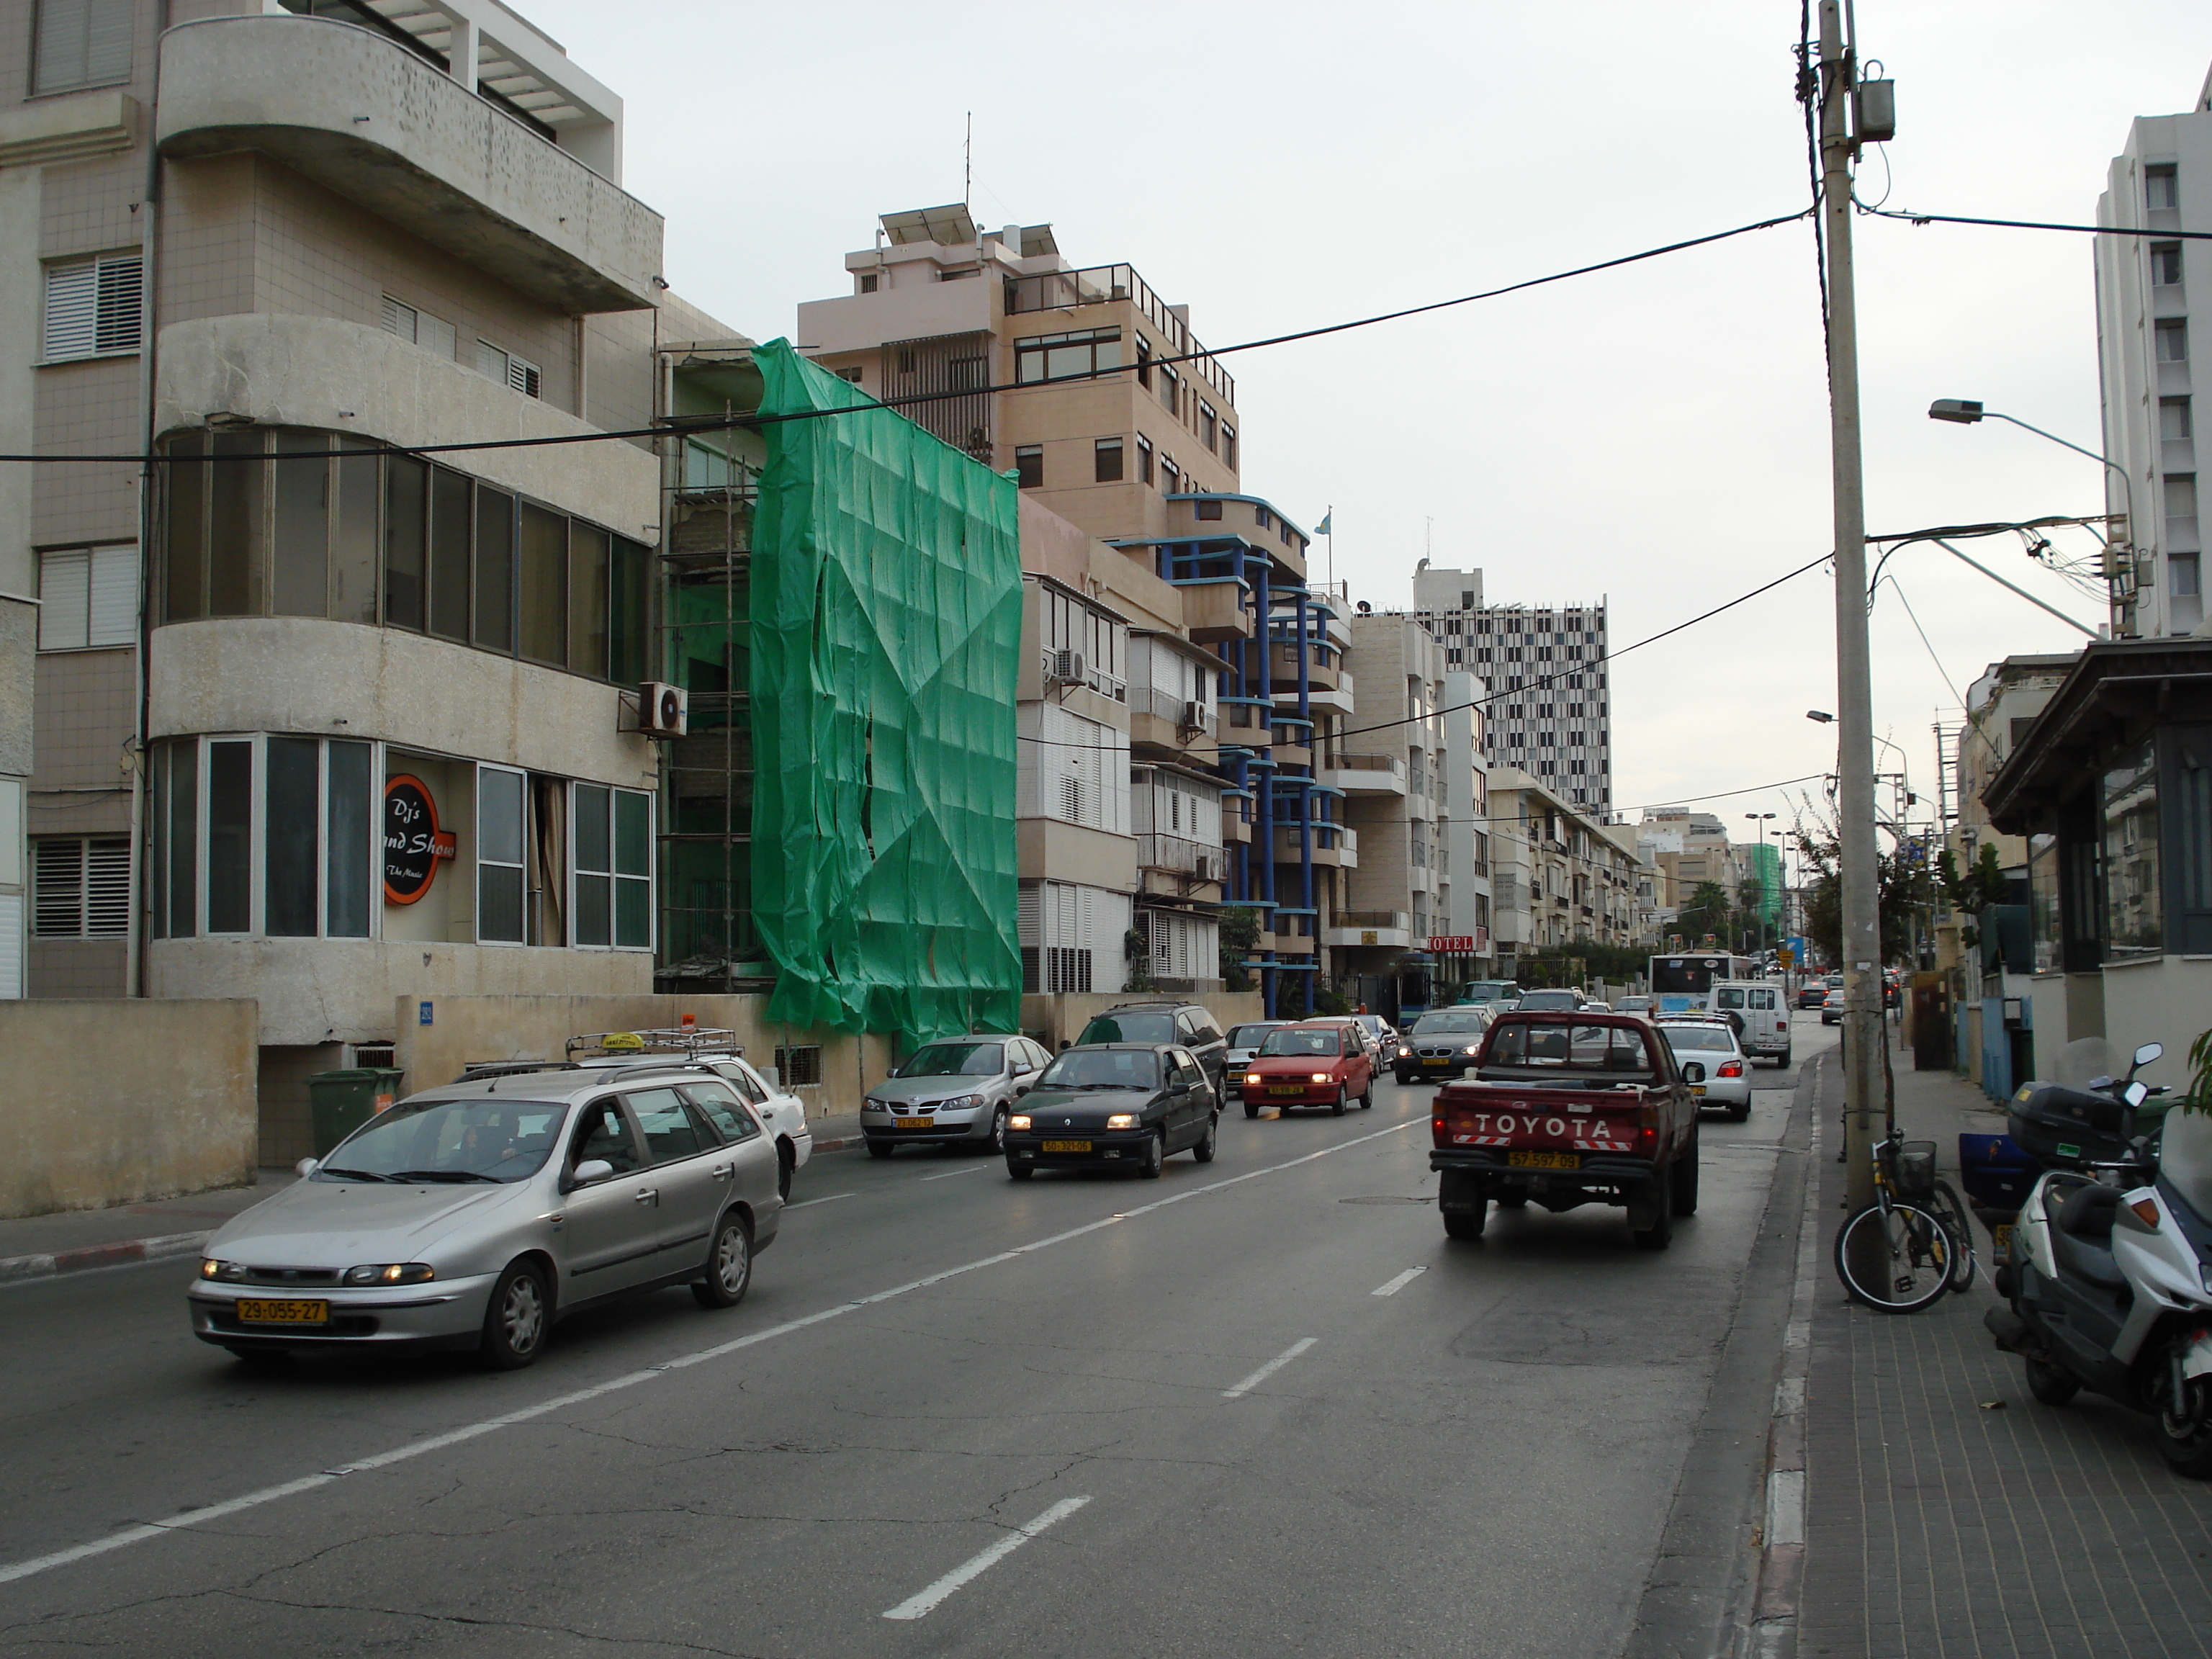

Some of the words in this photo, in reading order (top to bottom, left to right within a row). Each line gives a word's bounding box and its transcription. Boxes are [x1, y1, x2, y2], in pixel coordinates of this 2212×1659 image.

[391, 798, 421, 824] Dj's
[406, 833, 454, 856] Show
[386, 864, 403, 876] The
[403, 868, 423, 878] Music
[1475, 1114, 1611, 1138] TOYOTA
[1046, 1142, 1088, 1151] 50-321-06
[244, 1303, 321, 1320] 29-055-27
